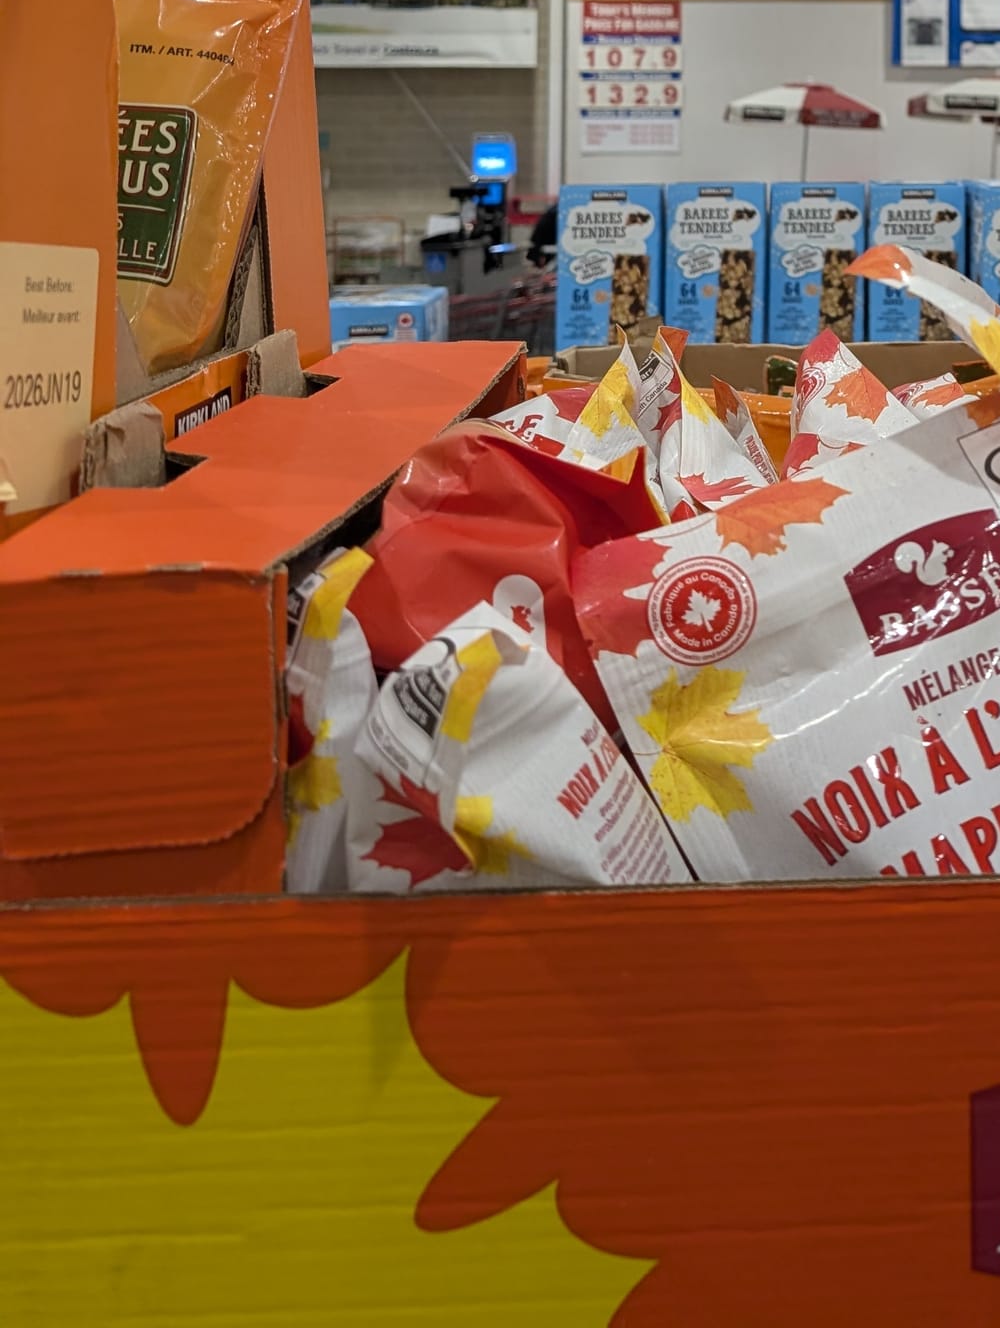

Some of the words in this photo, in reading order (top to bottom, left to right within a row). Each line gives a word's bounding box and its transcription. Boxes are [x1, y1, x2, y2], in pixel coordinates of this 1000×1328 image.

[130, 44, 156, 54] ITM.
[167, 47, 193, 57] ART.
[571, 227, 626, 239] TENDRES
[680, 222, 734, 234] TENDRES
[783, 222, 836, 234] TENDRES
[884, 223, 937, 236] TENDRES
[4, 370, 82, 410] 2026JN19
[700, 572, 735, 600] Canada
[701, 639, 713, 647] in
[713, 604, 738, 642] Canada
[556, 763, 600, 820] NOIX
[791, 746, 921, 866] NOIX
[916, 715, 970, 794] À
